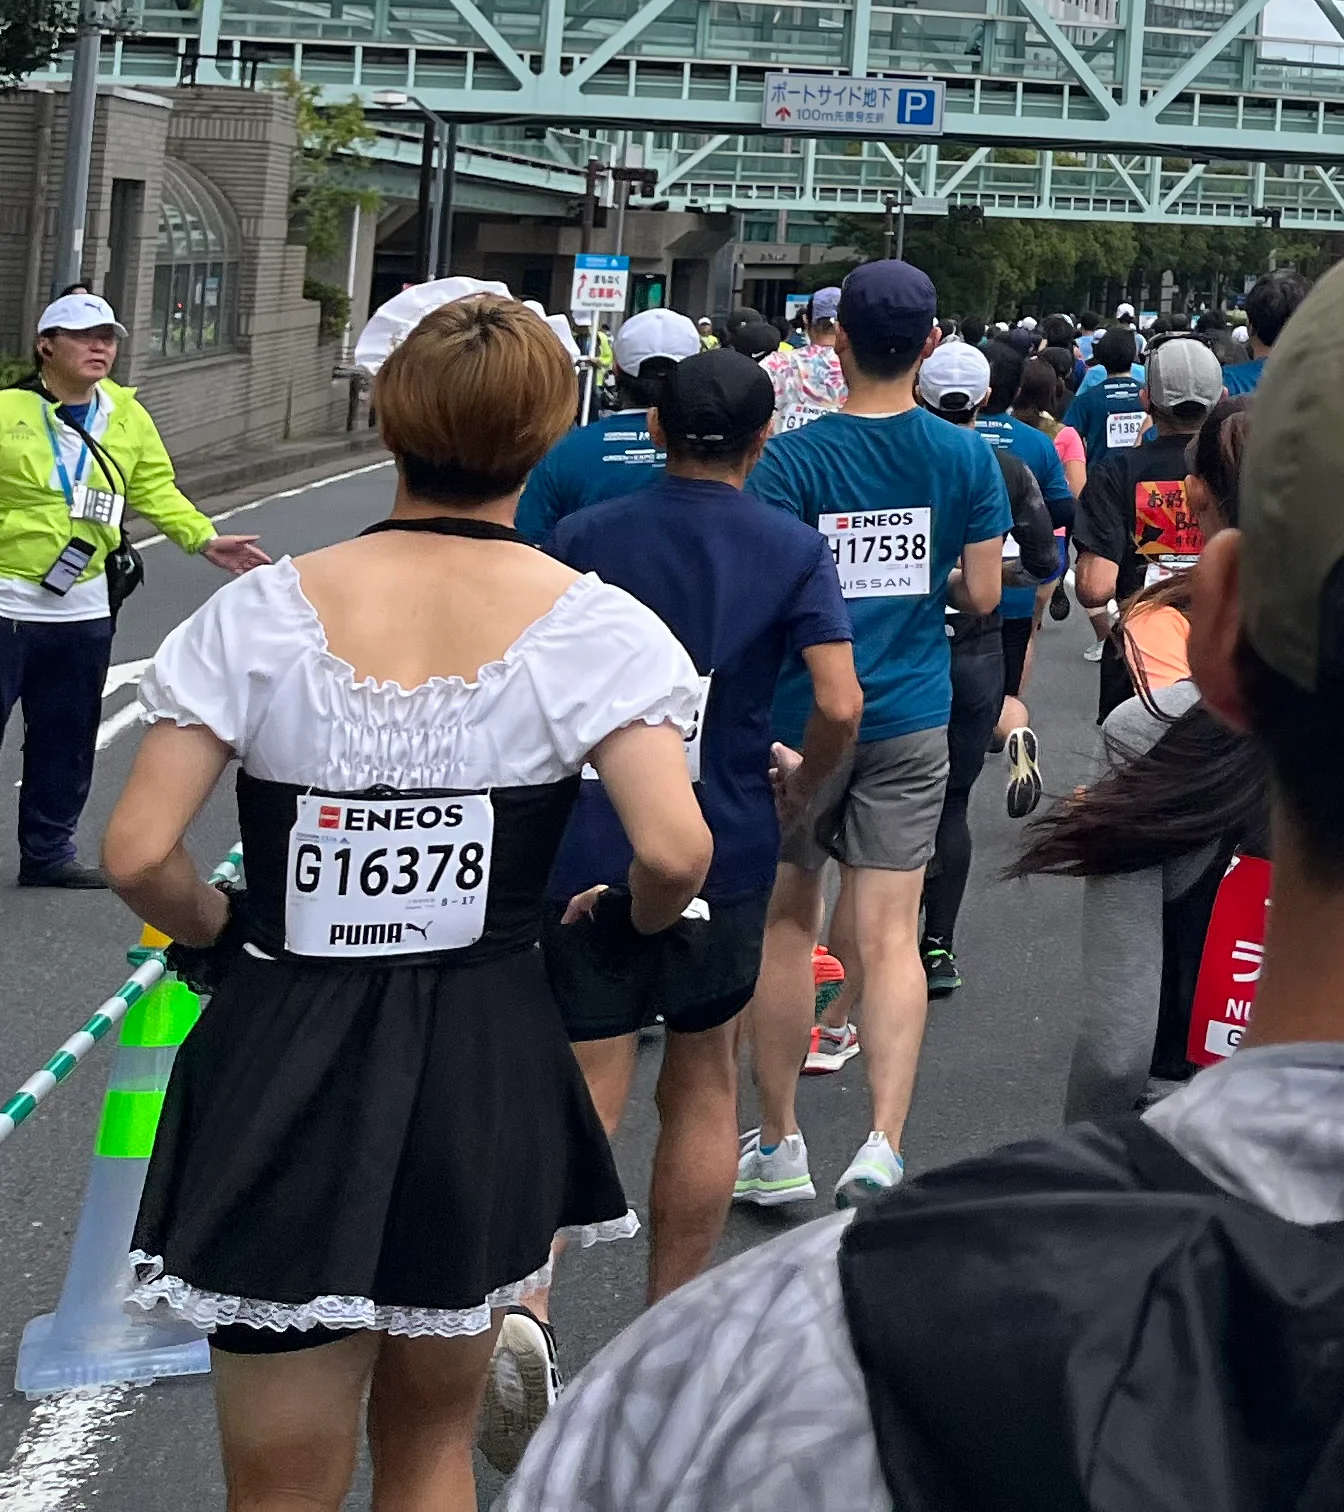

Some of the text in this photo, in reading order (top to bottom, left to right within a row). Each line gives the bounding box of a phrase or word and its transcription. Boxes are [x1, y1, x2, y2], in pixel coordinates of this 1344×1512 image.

[770, 80, 893, 109] ポートサイド地下
[904, 91, 928, 123] P
[851, 511, 914, 529] ENEOS
[344, 804, 464, 832] ENEOS
[294, 841, 485, 897] G16378
[329, 922, 403, 946] PUMA
